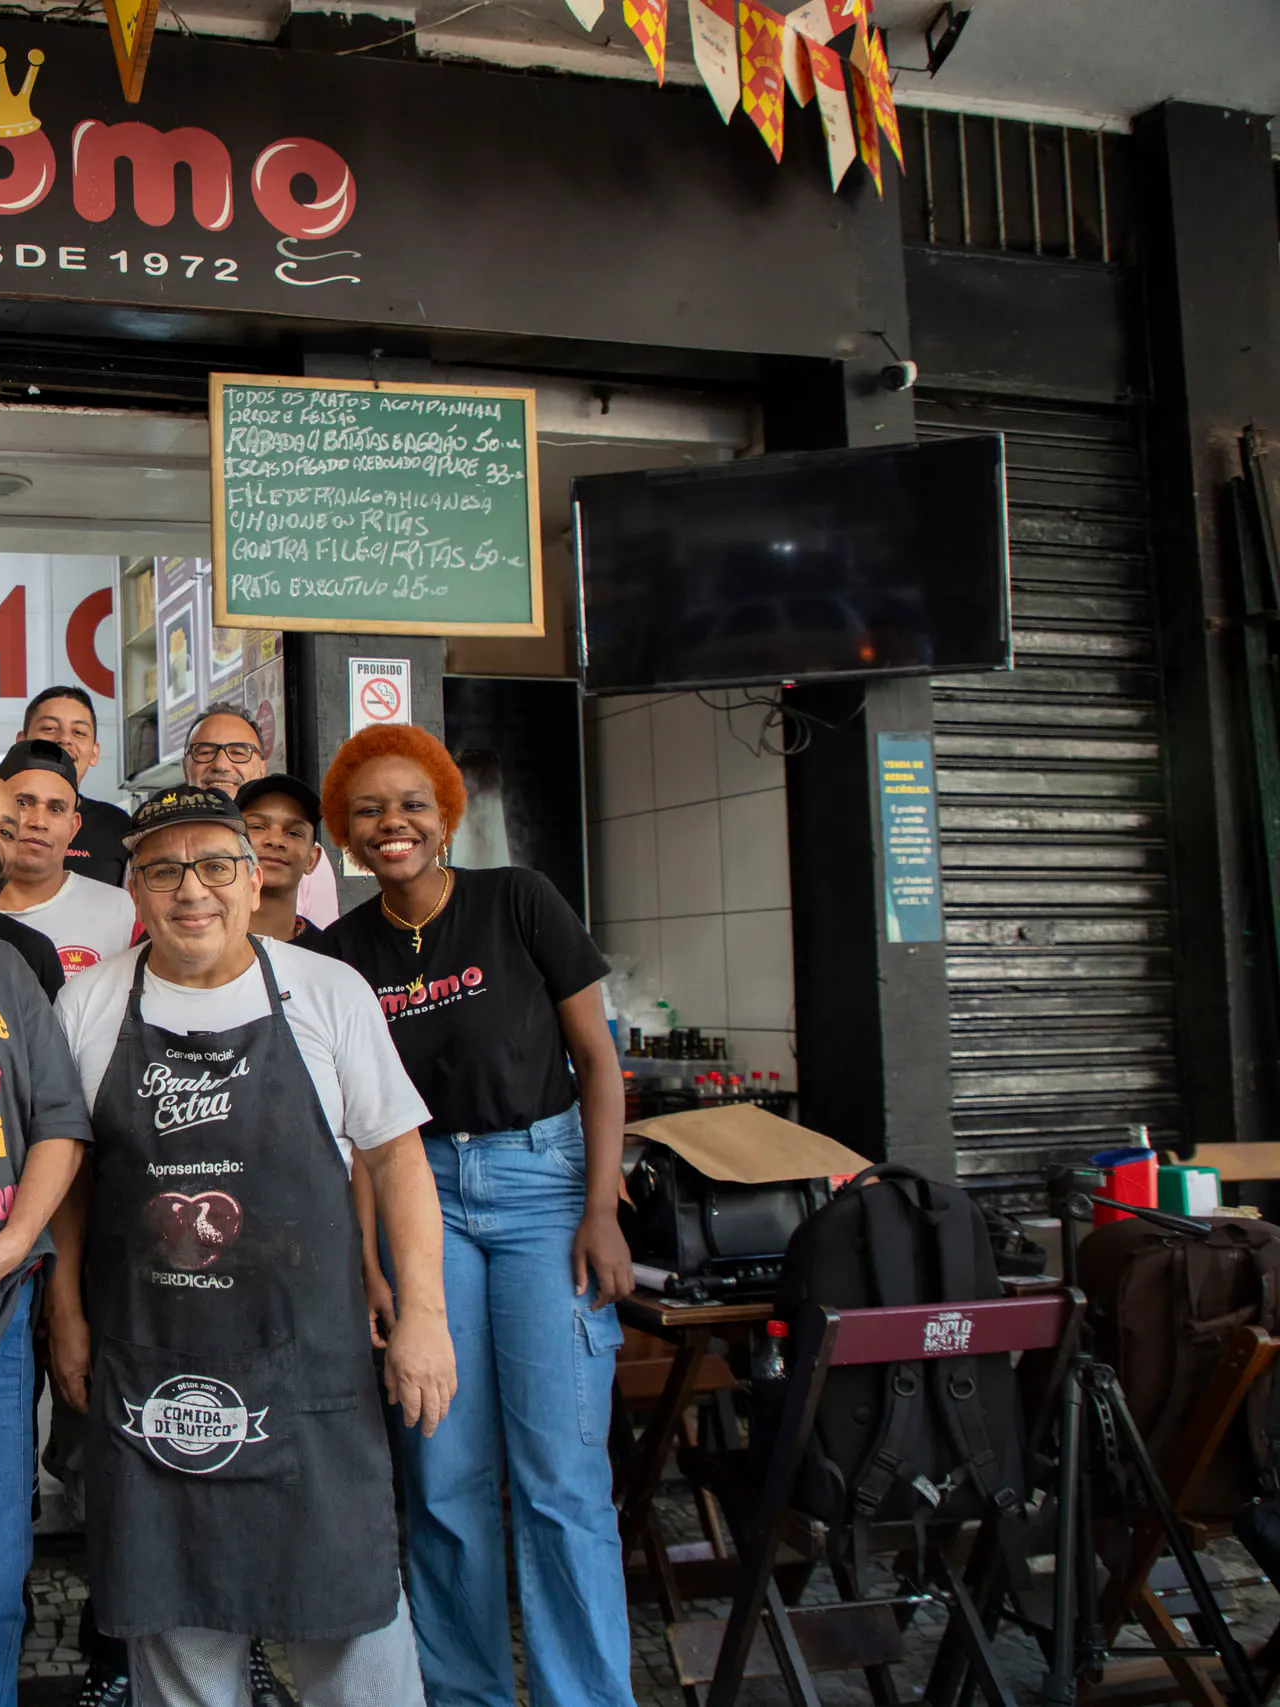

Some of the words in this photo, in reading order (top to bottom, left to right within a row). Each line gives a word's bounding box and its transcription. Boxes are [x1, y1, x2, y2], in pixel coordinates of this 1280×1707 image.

[110, 249, 239, 283] 1972
[223, 388, 275, 409] TODOS
[282, 391, 305, 406] OS
[310, 391, 371, 410] PRATOS
[380, 398, 501, 421] ACOMPANHAM
[229, 408, 281, 425] ARROZ
[225, 425, 305, 457] RABADA
[223, 456, 280, 479] ISCAS
[314, 486, 383, 508] FRANGO
[400, 490, 492, 515] MILANESA
[360, 508, 429, 537] FRITAS
[231, 535, 310, 563] CONTRA
[231, 570, 282, 601] PRATO
[289, 574, 388, 598] EXECUTIVO
[357, 663, 402, 676] PROIBIDO
[378, 986, 394, 995] BAR
[395, 985, 406, 993] do
[380, 966, 483, 1015] momo
[400, 1004, 436, 1018] DESDE
[438, 993, 463, 1007] 1972
[166, 1048, 202, 1061] Cerveja
[204, 1048, 236, 1062] Oficial:
[154, 1091, 233, 1130] Extra
[146, 1159, 244, 1178] Apresentação:
[152, 1271, 234, 1289] PERDIGÃO
[177, 1383, 199, 1391] DESDE
[200, 1383, 217, 1393] 2000
[155, 1420, 171, 1434] DI
[163, 1406, 222, 1424] COMIDA
